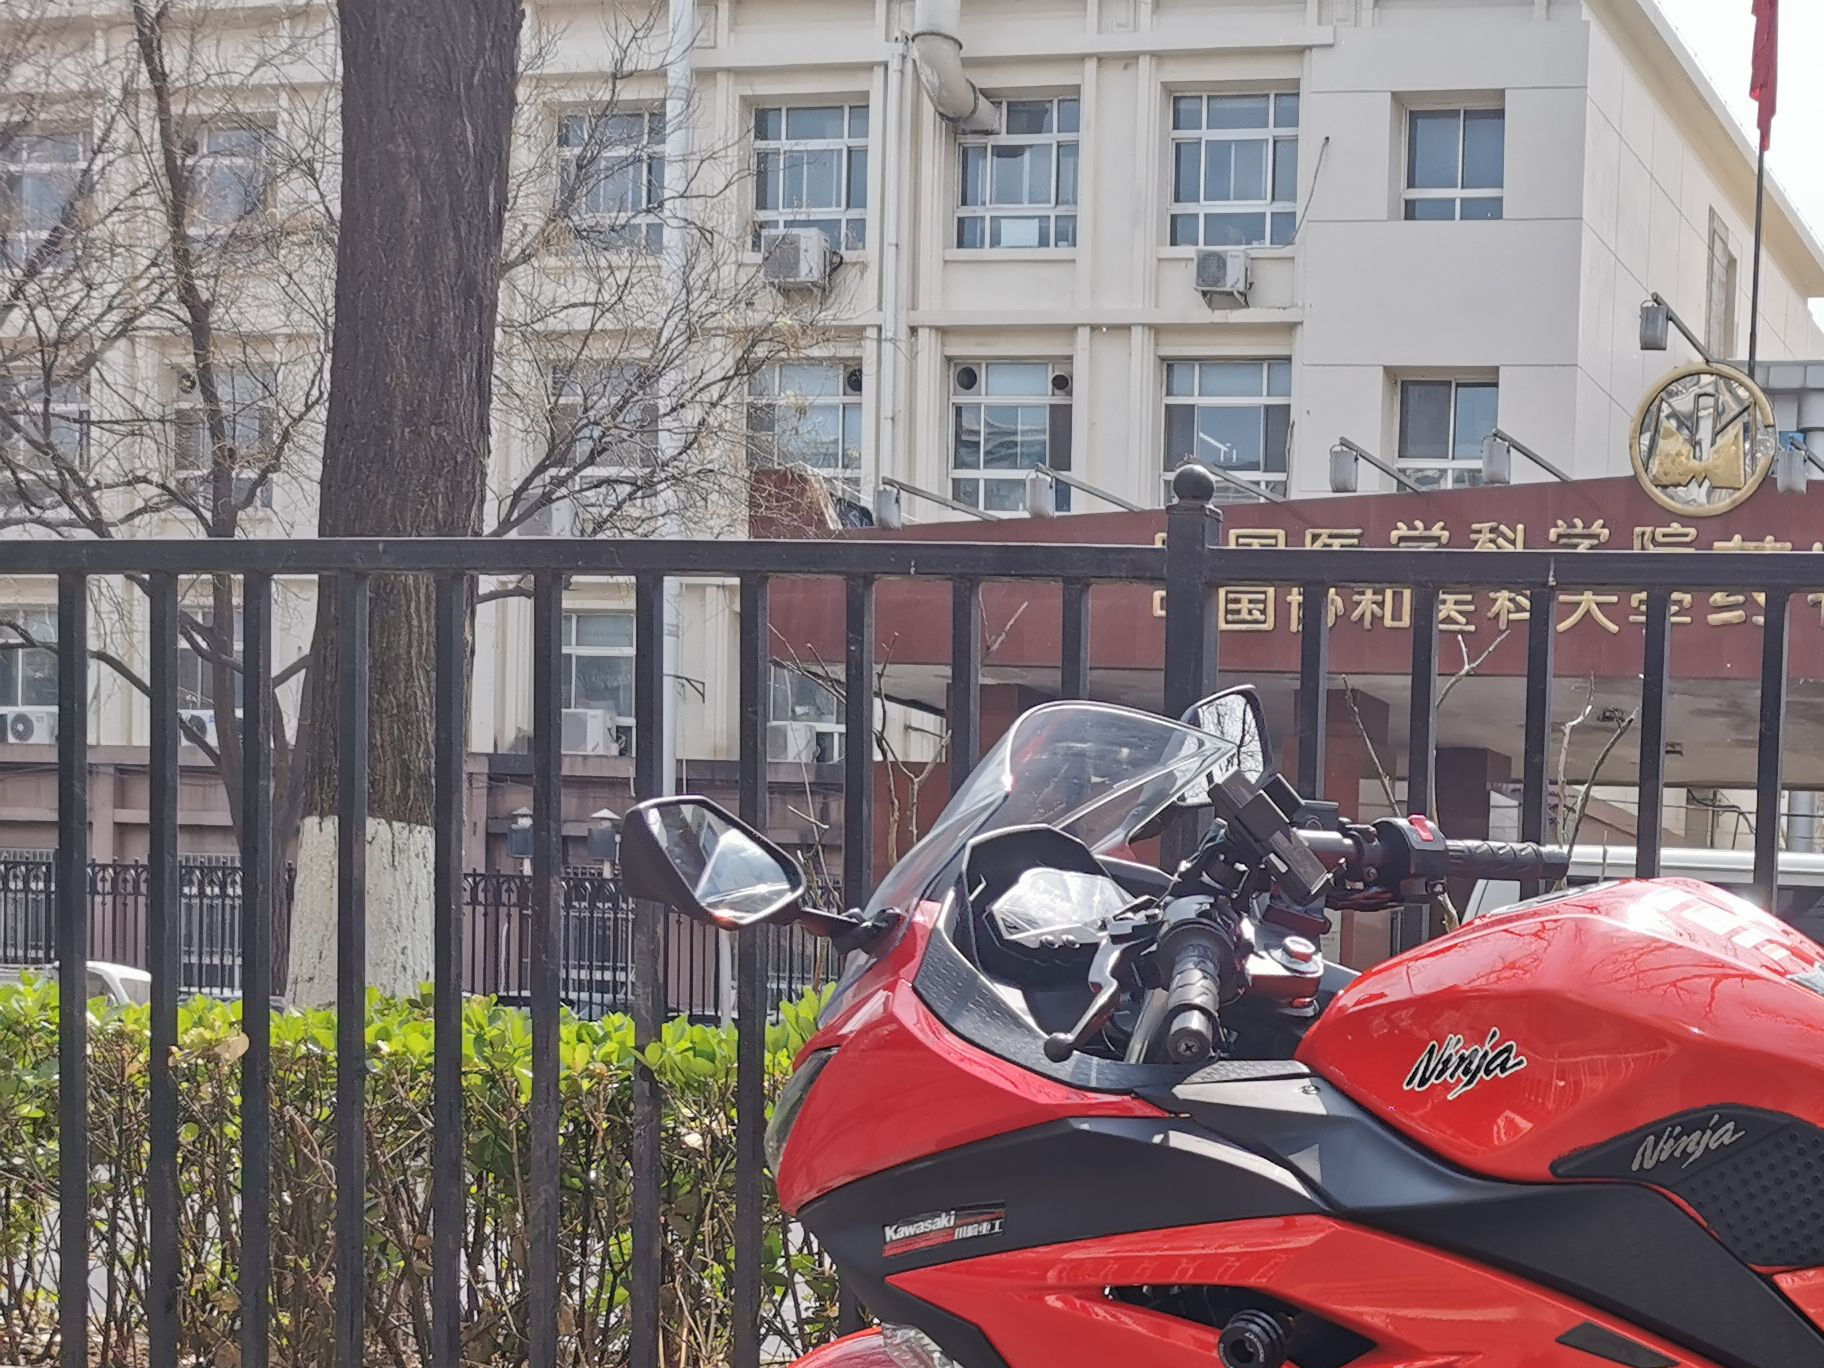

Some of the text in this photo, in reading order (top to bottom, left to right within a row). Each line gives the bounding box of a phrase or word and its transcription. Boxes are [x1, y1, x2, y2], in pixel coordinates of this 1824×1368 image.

[1402, 1026, 1528, 1101] Ninja
[1630, 1113, 1747, 1174] Ninja
[884, 1210, 956, 1243] Kawasaki
